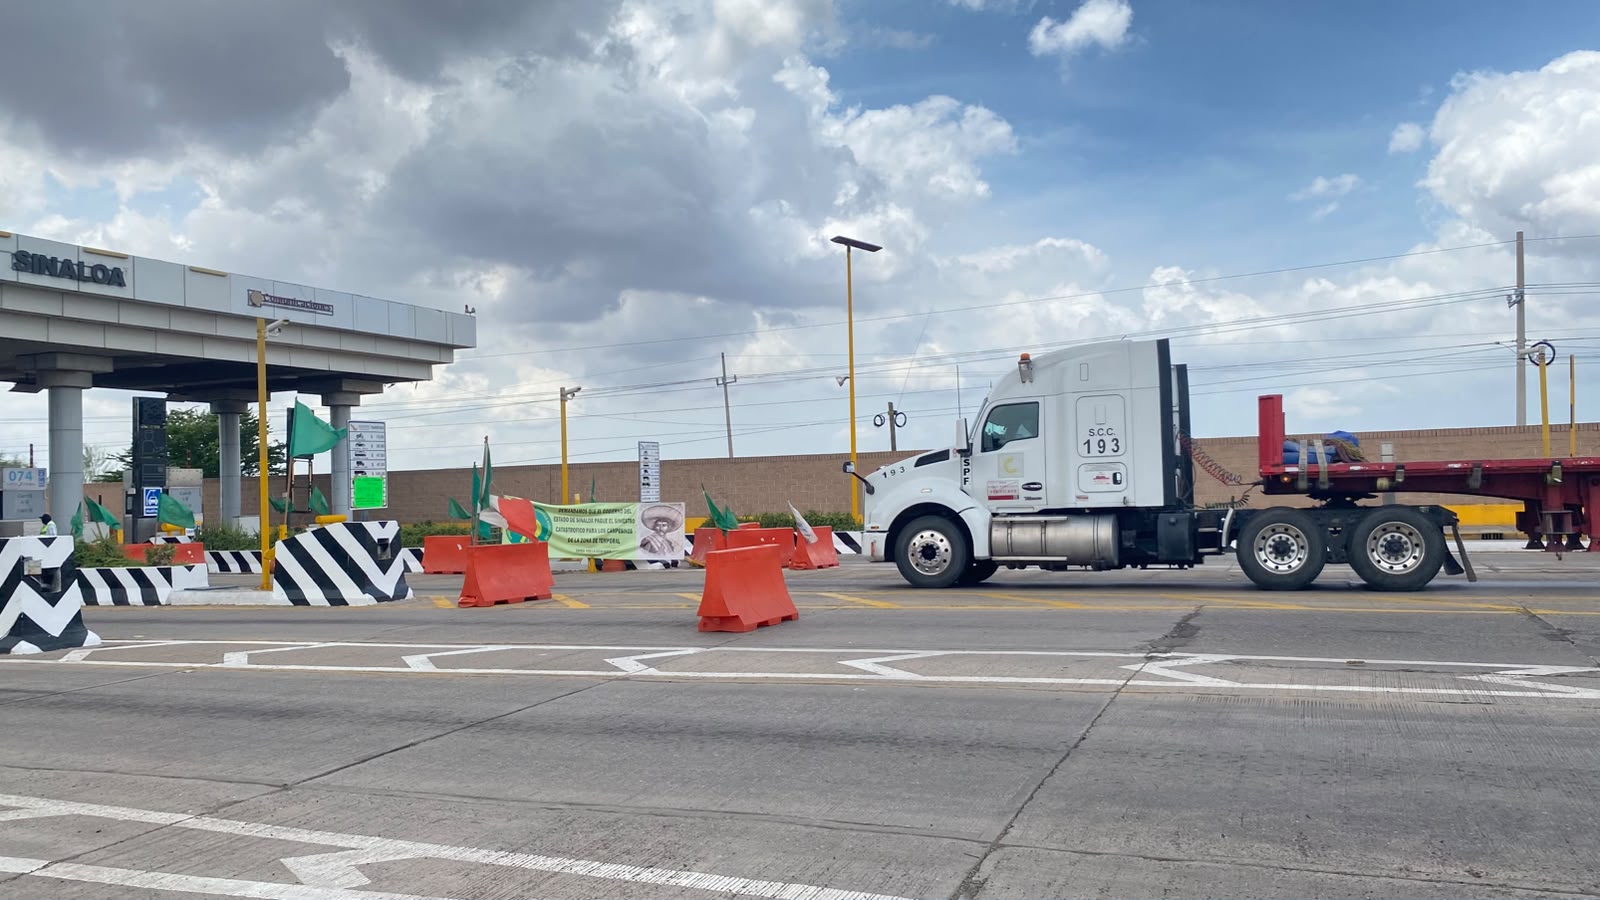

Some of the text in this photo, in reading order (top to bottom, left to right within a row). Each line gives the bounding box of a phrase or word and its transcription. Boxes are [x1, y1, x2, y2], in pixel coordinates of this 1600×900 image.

[12, 250, 127, 287] SINALOA
[1088, 427, 1116, 437] S.C.C.
[1083, 437, 1120, 454] 193
[9, 470, 33, 481] 074
[881, 466, 905, 478] 193
